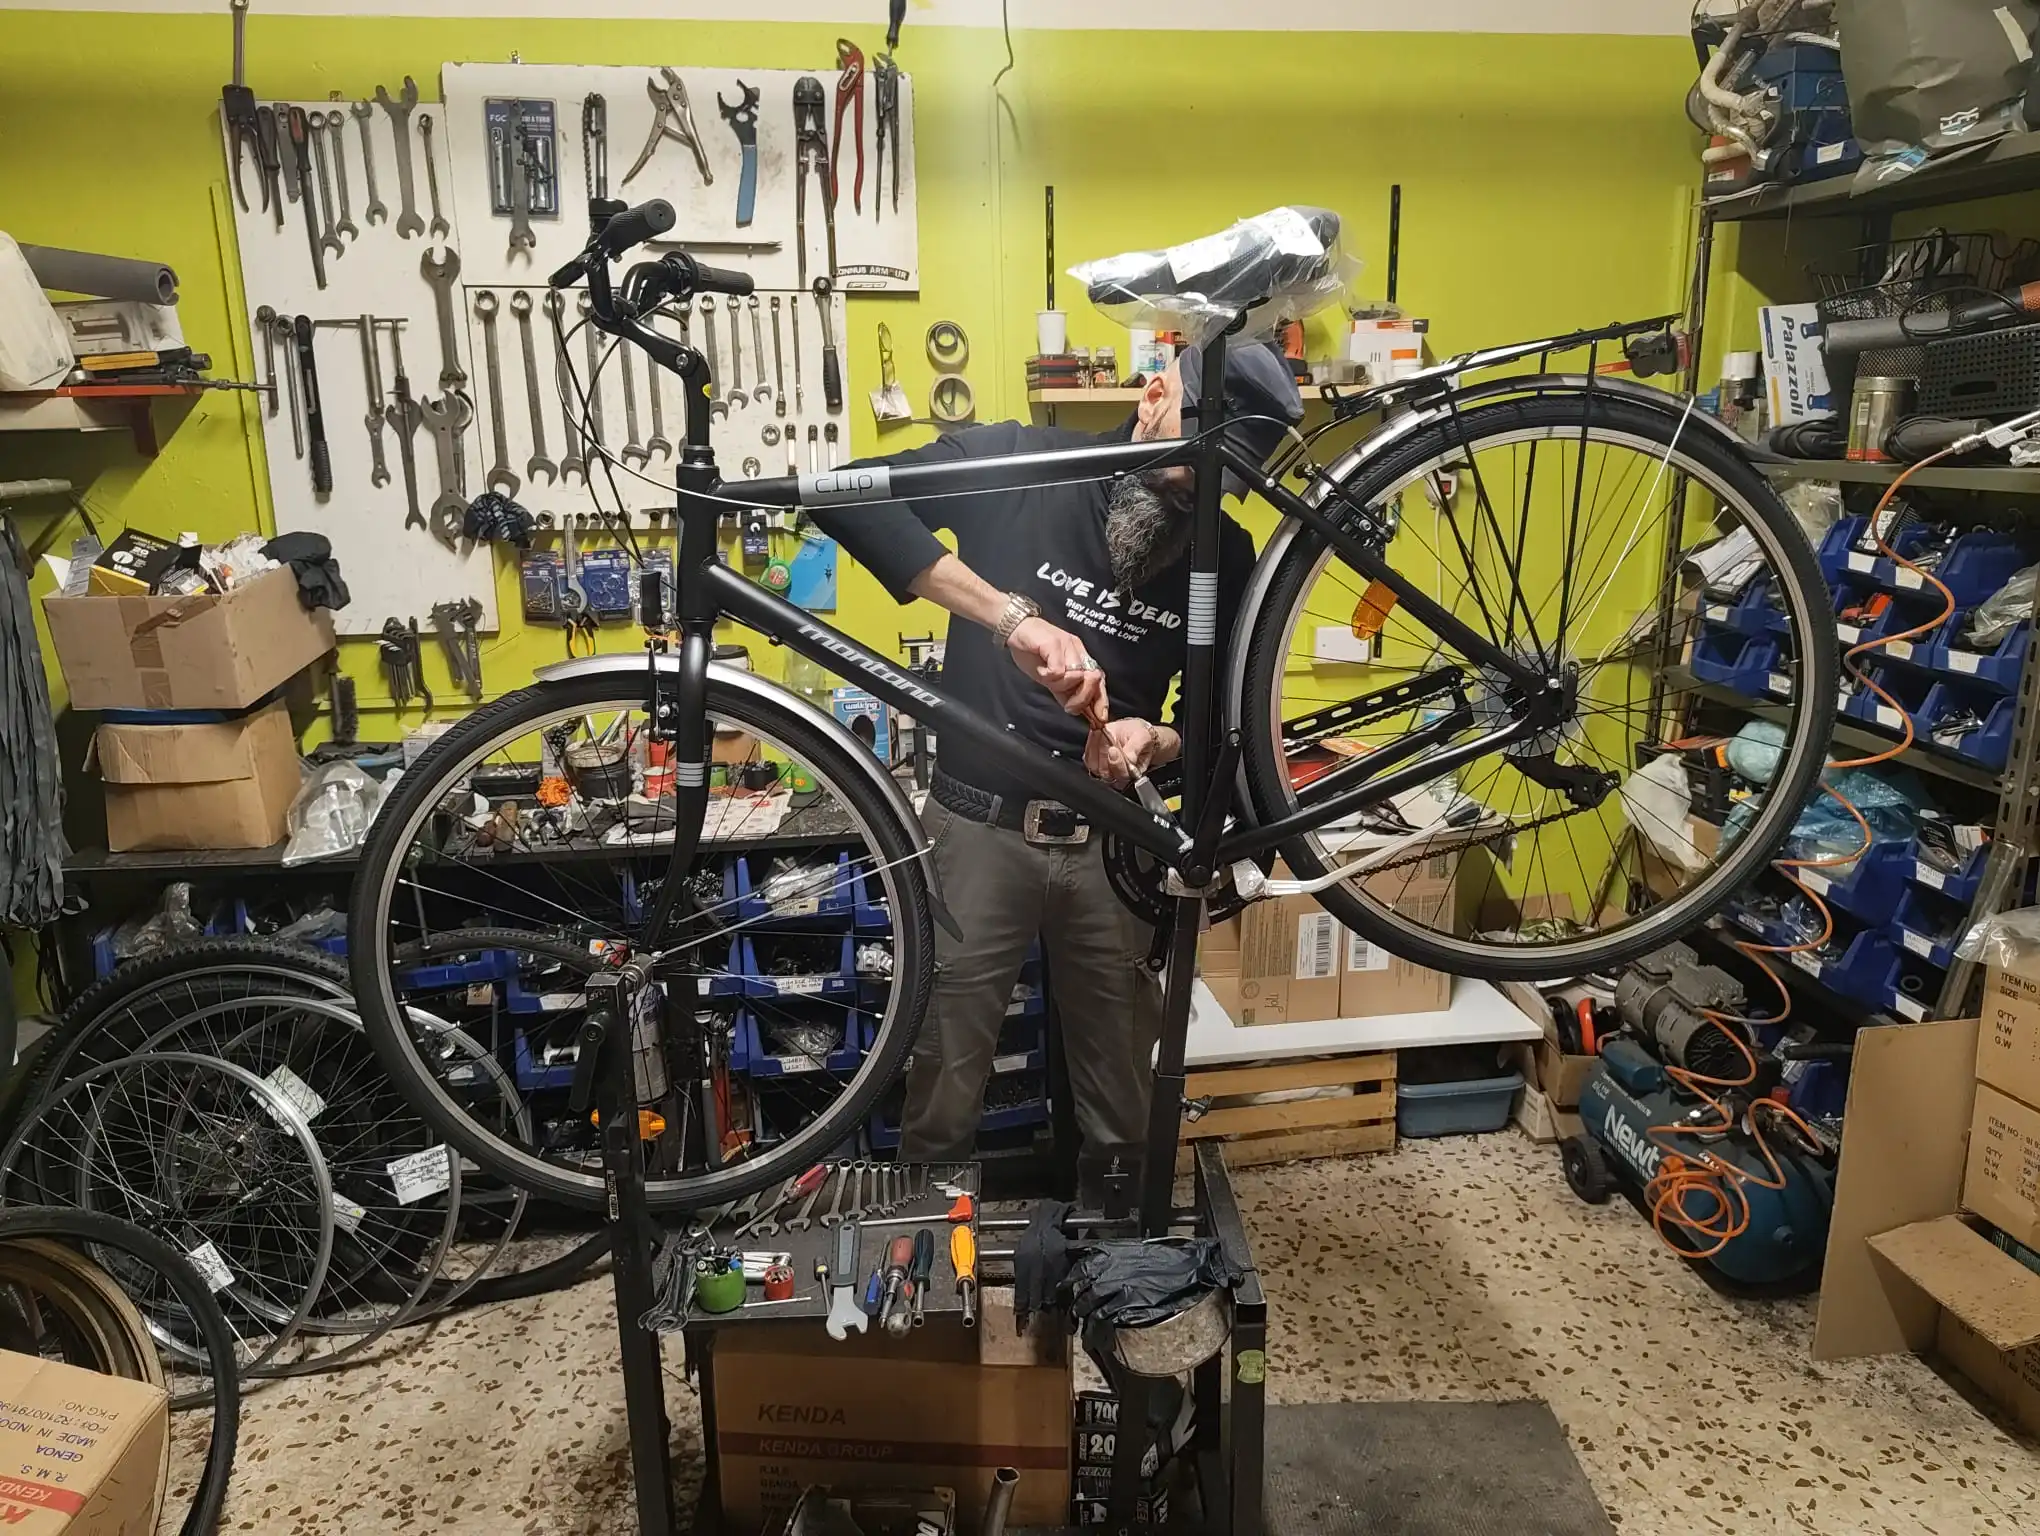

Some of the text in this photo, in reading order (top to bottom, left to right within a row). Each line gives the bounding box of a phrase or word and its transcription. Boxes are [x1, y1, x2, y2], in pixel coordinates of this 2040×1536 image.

[1781, 315, 1804, 416] Palazzoli
[1036, 562, 1181, 629] LOVE IS DEAD
[1065, 598, 1148, 635] THEY LOVE TOO MUCH
[1066, 609, 1084, 623] THAT
[1084, 617, 1098, 628] DIE
[1100, 624, 1117, 636] FOR
[798, 623, 945, 707] montana
[2001, 972, 2021, 986] ITEM
[2000, 985, 2019, 1000] SIZE
[1997, 1009, 2017, 1024] Q'TY
[1988, 1116, 2006, 1131] ITEM
[1988, 1126, 2003, 1141] SIZE
[757, 1403, 846, 1426] KENDA
[0, 1416, 97, 1447] MADE IN INDO
[36, 1445, 84, 1463] GENOA
[759, 1439, 894, 1458] KENDA GROUP
